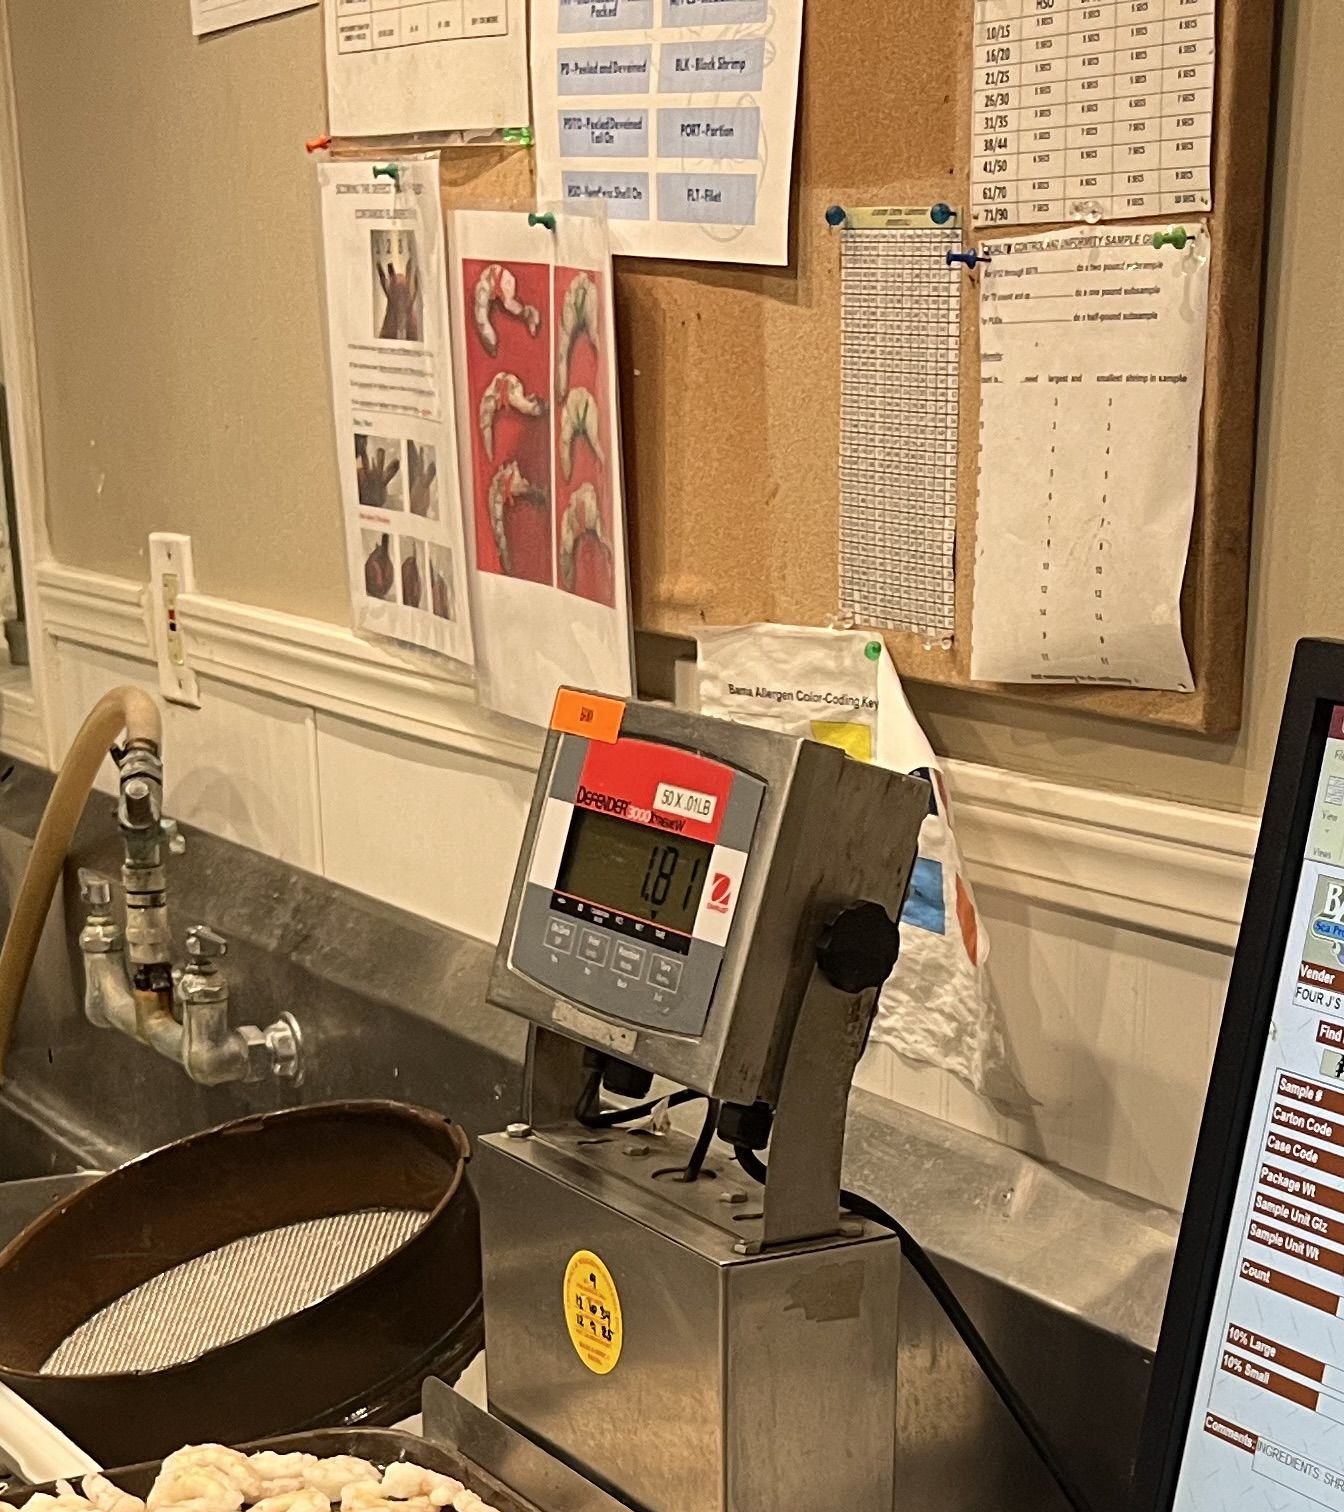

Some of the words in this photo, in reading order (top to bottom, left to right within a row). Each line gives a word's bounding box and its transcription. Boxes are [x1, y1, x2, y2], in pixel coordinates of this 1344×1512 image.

[987, 25, 1010, 40] 10/15
[986, 48, 1010, 63] 16/20
[985, 70, 1009, 85] 21/25
[1106, 234, 1141, 245] SAMPLE
[755, 686, 794, 702] Allergen
[795, 691, 860, 709] Color-Coding
[861, 696, 879, 711] Key
[641, 846, 701, 911] 1.81
[1300, 964, 1334, 985] Vender
[1295, 986, 1323, 1005] FOUR
[1324, 993, 1342, 1010] J'S
[1261, 1167, 1299, 1192] Package
[1301, 1180, 1316, 1198] Wt
[1241, 1261, 1271, 1284] Count
